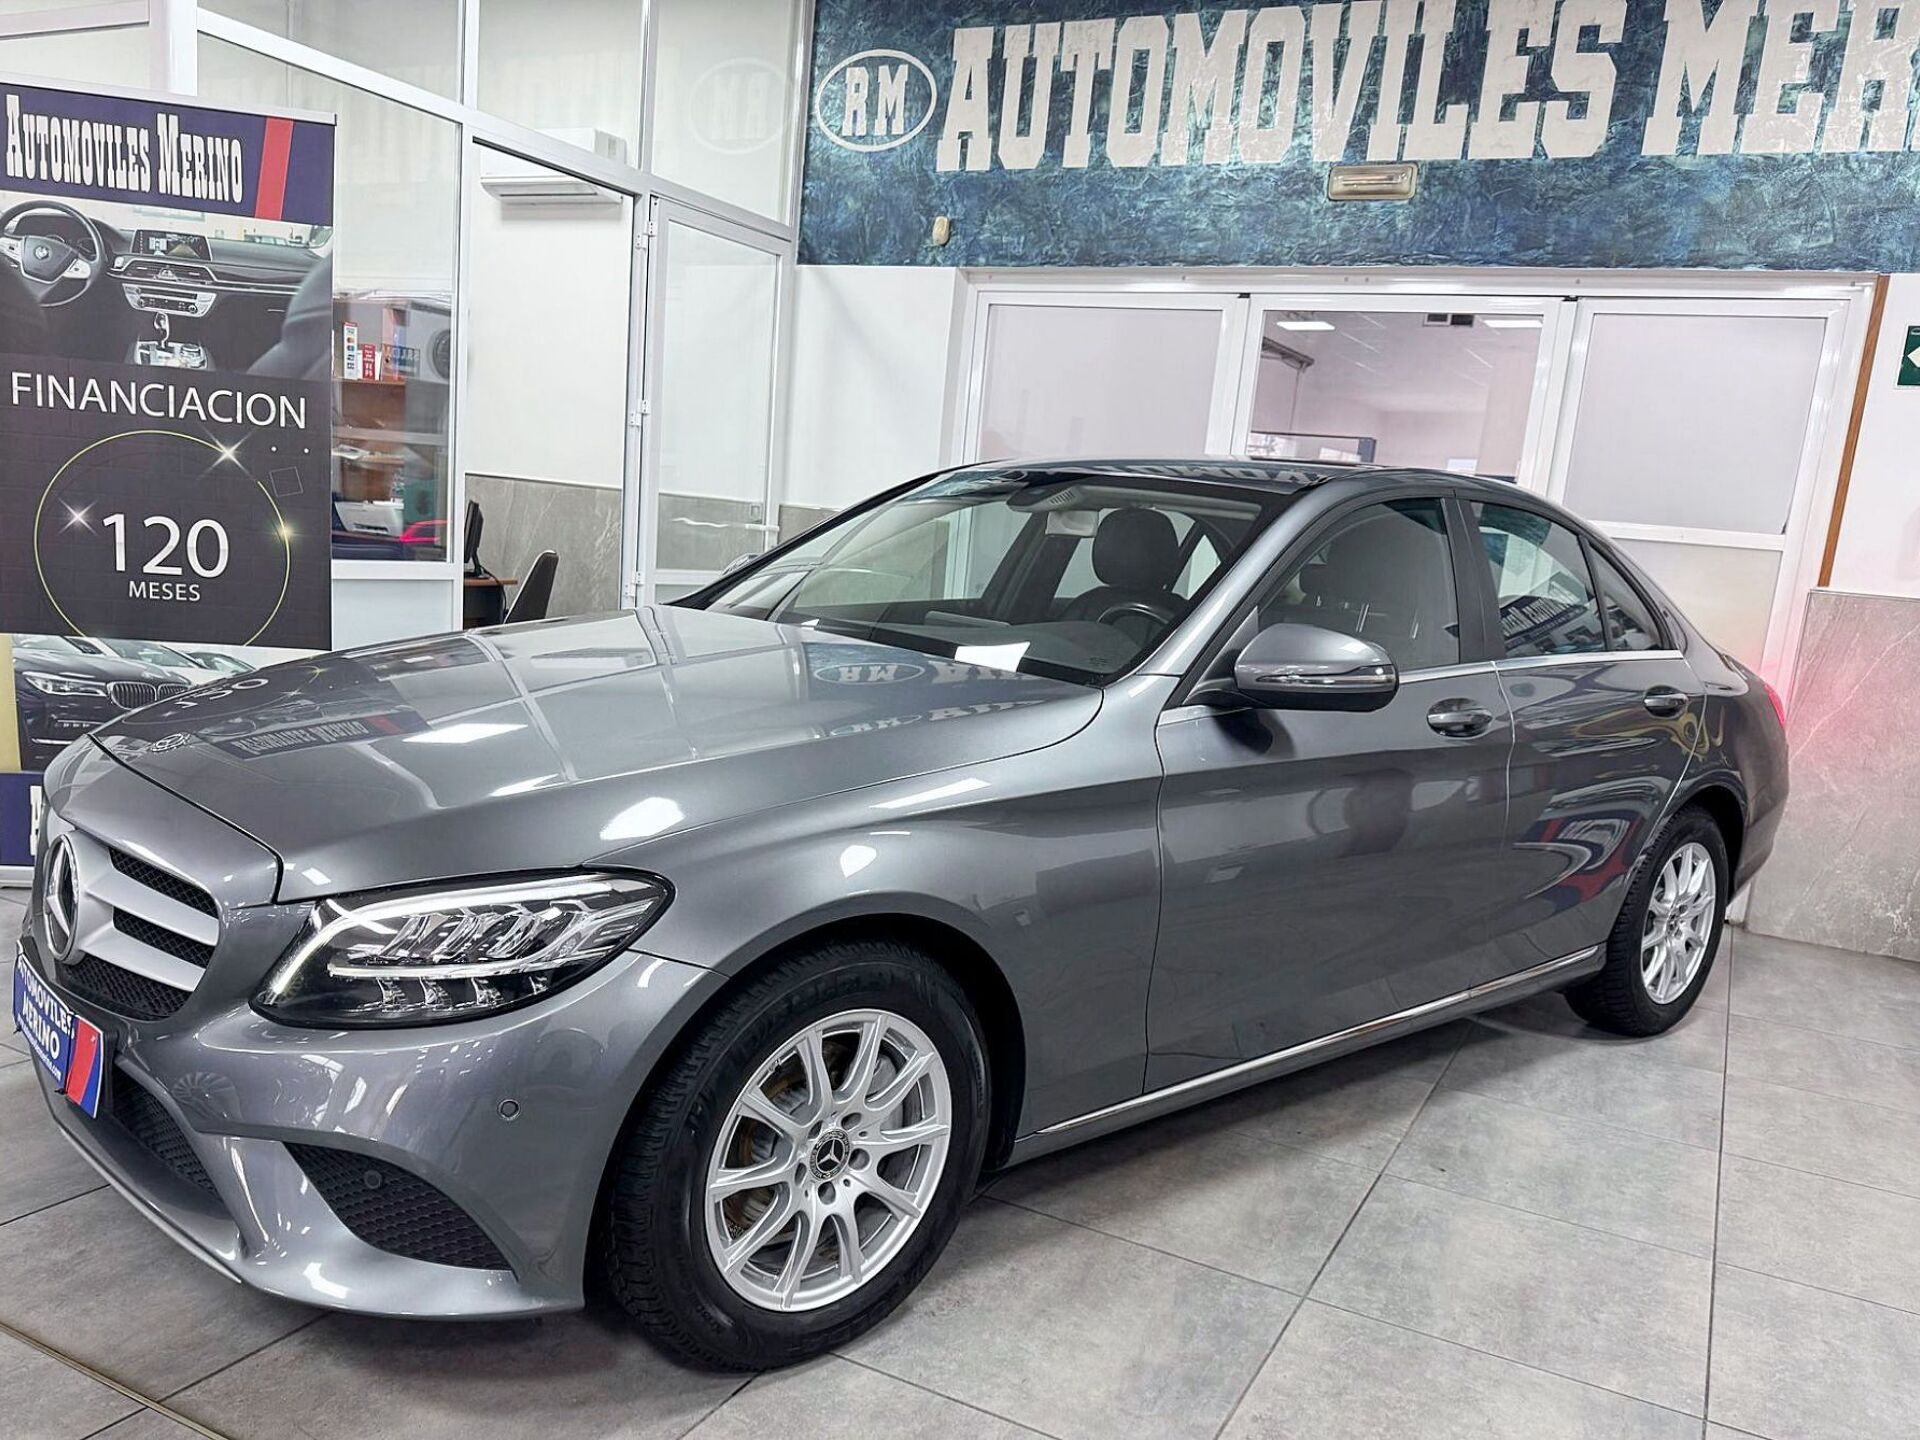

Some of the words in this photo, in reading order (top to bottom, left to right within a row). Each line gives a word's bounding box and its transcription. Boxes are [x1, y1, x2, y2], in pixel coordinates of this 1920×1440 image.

[841, 64, 909, 137] RM
[935, 0, 1628, 172] AUTOMOVILES
[1640, 0, 1920, 156] MER
[5, 94, 151, 193] AUTOMOVILES
[156, 112, 243, 204] MERINO
[10, 371, 307, 429] FINANCIACION
[102, 512, 230, 579] 120
[128, 580, 201, 602] MESES
[22, 990, 60, 1060] MERINO
